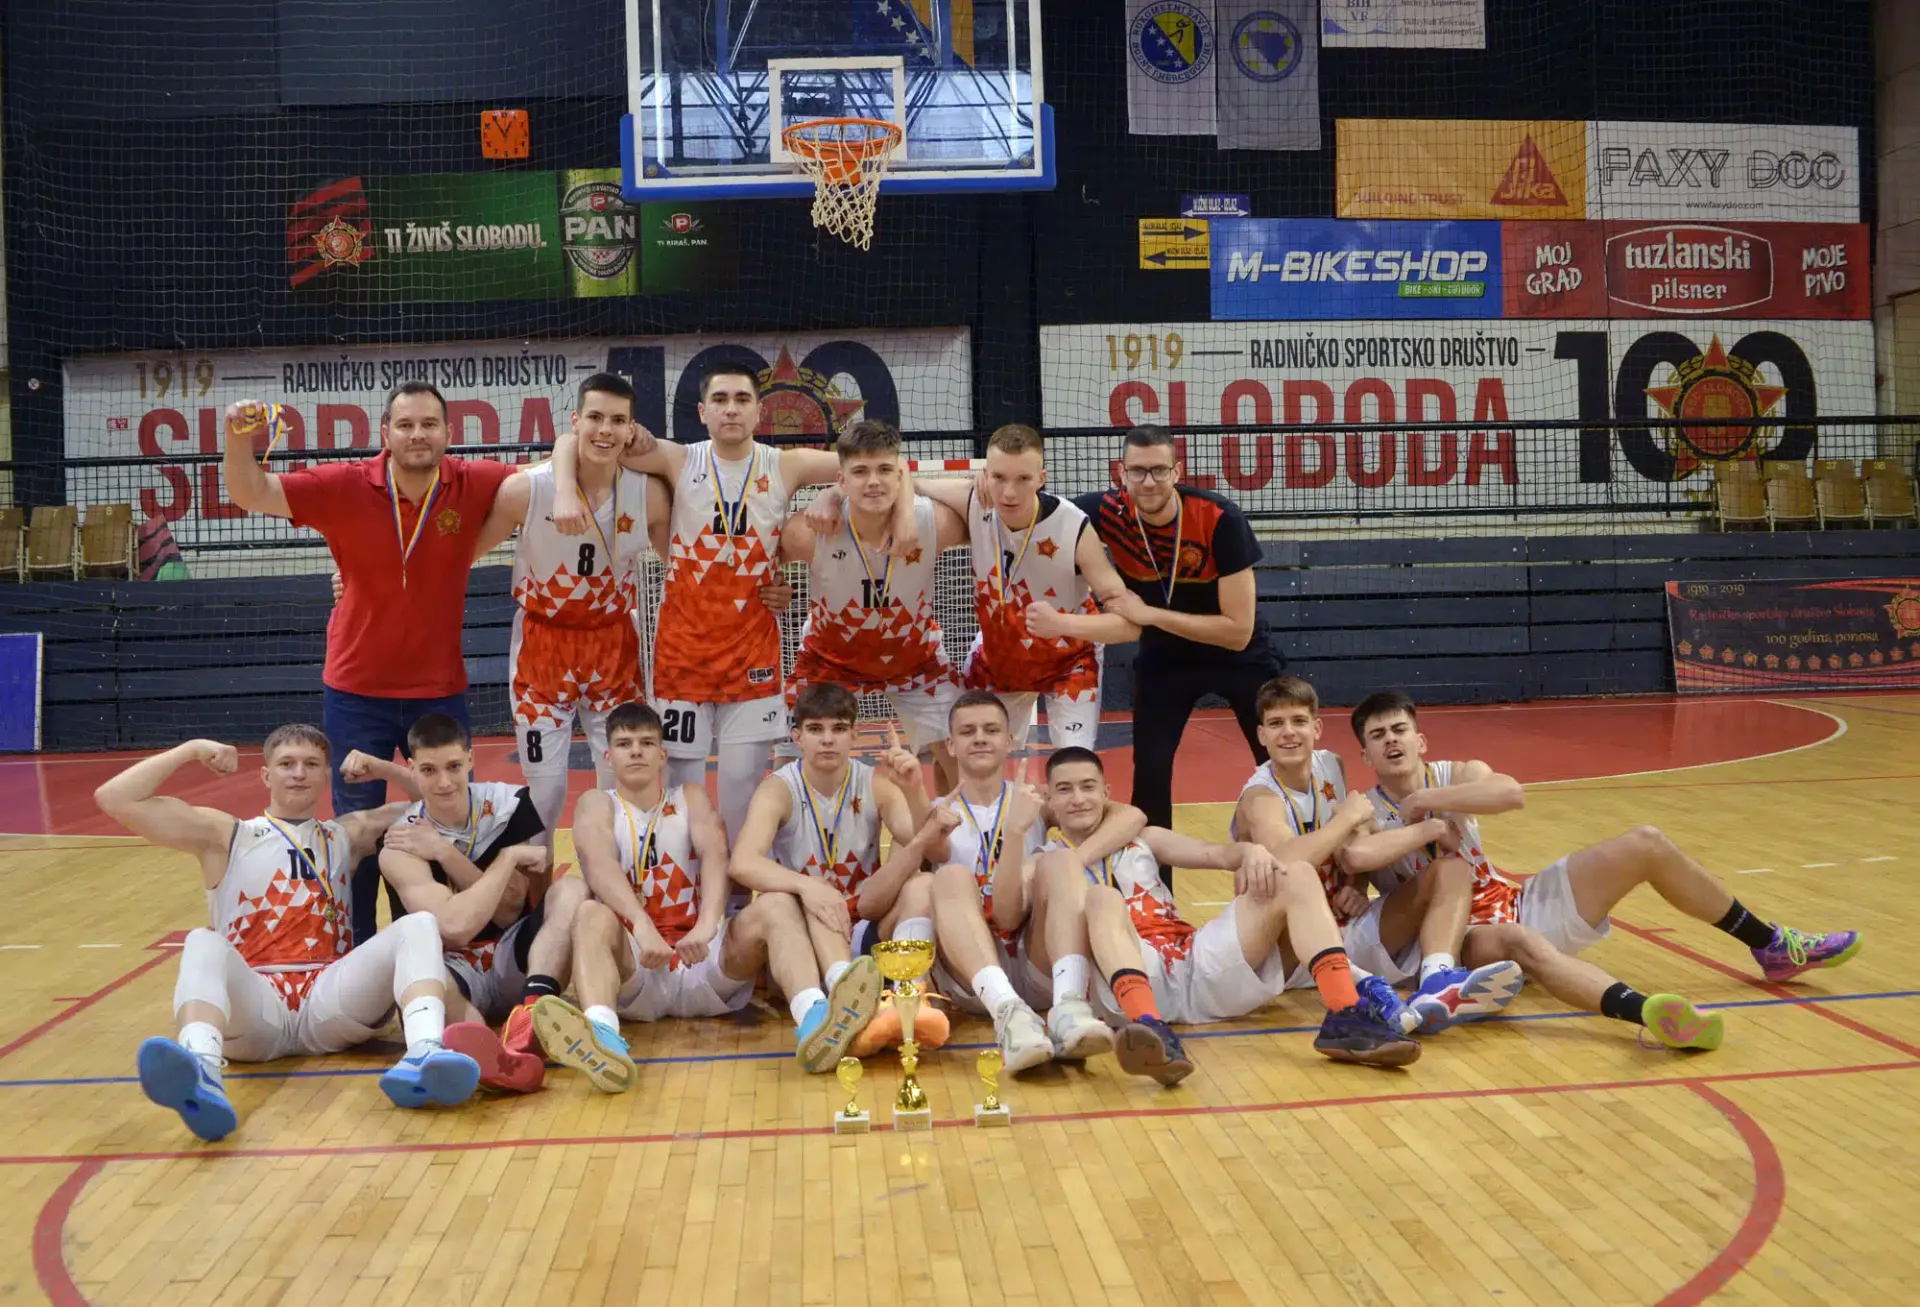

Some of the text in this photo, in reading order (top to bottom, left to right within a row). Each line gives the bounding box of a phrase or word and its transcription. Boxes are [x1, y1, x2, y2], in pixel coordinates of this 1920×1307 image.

[1603, 147, 1730, 188] FAXY
[384, 221, 547, 253] TI ŽIVIŠ SLOBODU.
[564, 215, 636, 241] PAN
[1227, 250, 1488, 283] M-BIKESHOP
[1536, 241, 1573, 269] MOJ
[1625, 232, 1752, 270] tuzlanski
[1802, 244, 1848, 271] MOJE
[1405, 285, 1421, 294] BIKE
[1526, 267, 1583, 297] GRAD
[1650, 277, 1728, 305] pilsner
[1105, 329, 1519, 372] 1919 RADNIČKO SPORTSKO DRUŠTVO
[135, 359, 215, 399] 1919
[282, 353, 375, 395] RADNIČKO
[482, 347, 567, 387] DRUŠTVO
[1554, 330, 1818, 484] 100
[577, 543, 596, 577] 8
[1720, 583, 1745, 597] 2019
[1789, 628, 1833, 649] godina
[1835, 630, 1880, 646] ponosa
[663, 708, 696, 744] 20
[526, 730, 543, 763] 8
